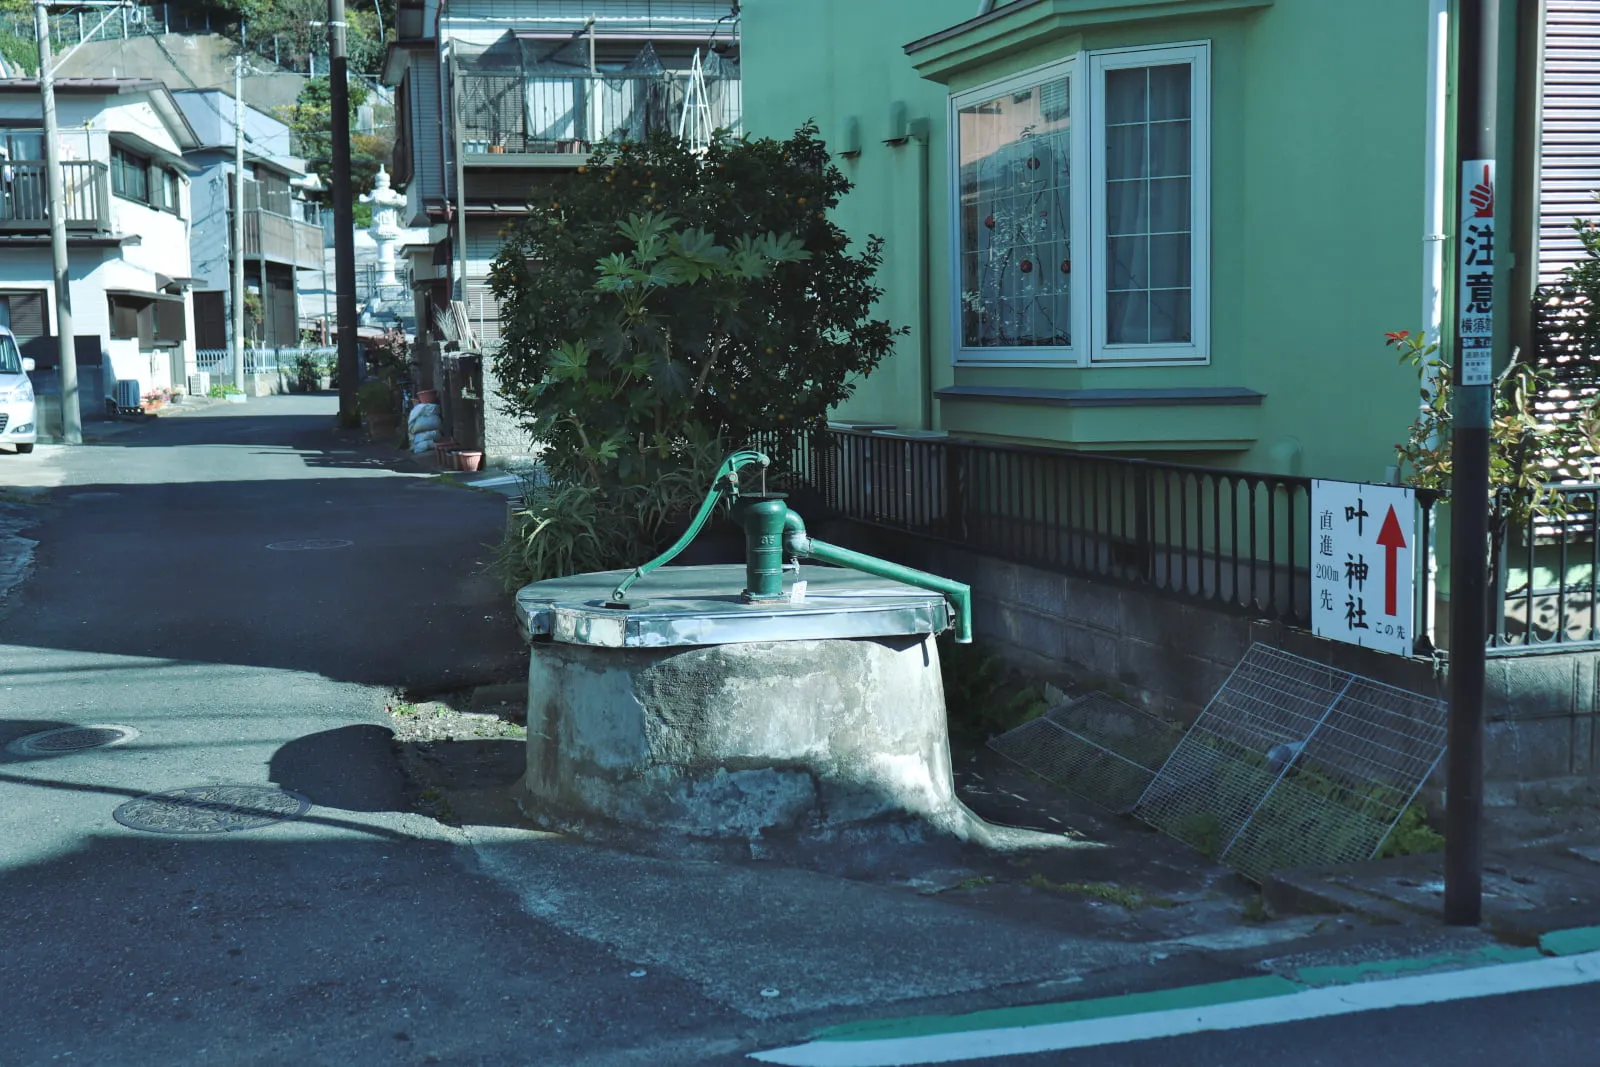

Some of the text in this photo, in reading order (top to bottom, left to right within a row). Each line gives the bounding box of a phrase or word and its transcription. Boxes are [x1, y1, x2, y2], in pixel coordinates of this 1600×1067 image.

[1465, 224, 1494, 314] 注意
[1344, 498, 1369, 631] 叶神社
[1375, 621, 1405, 640] この先
